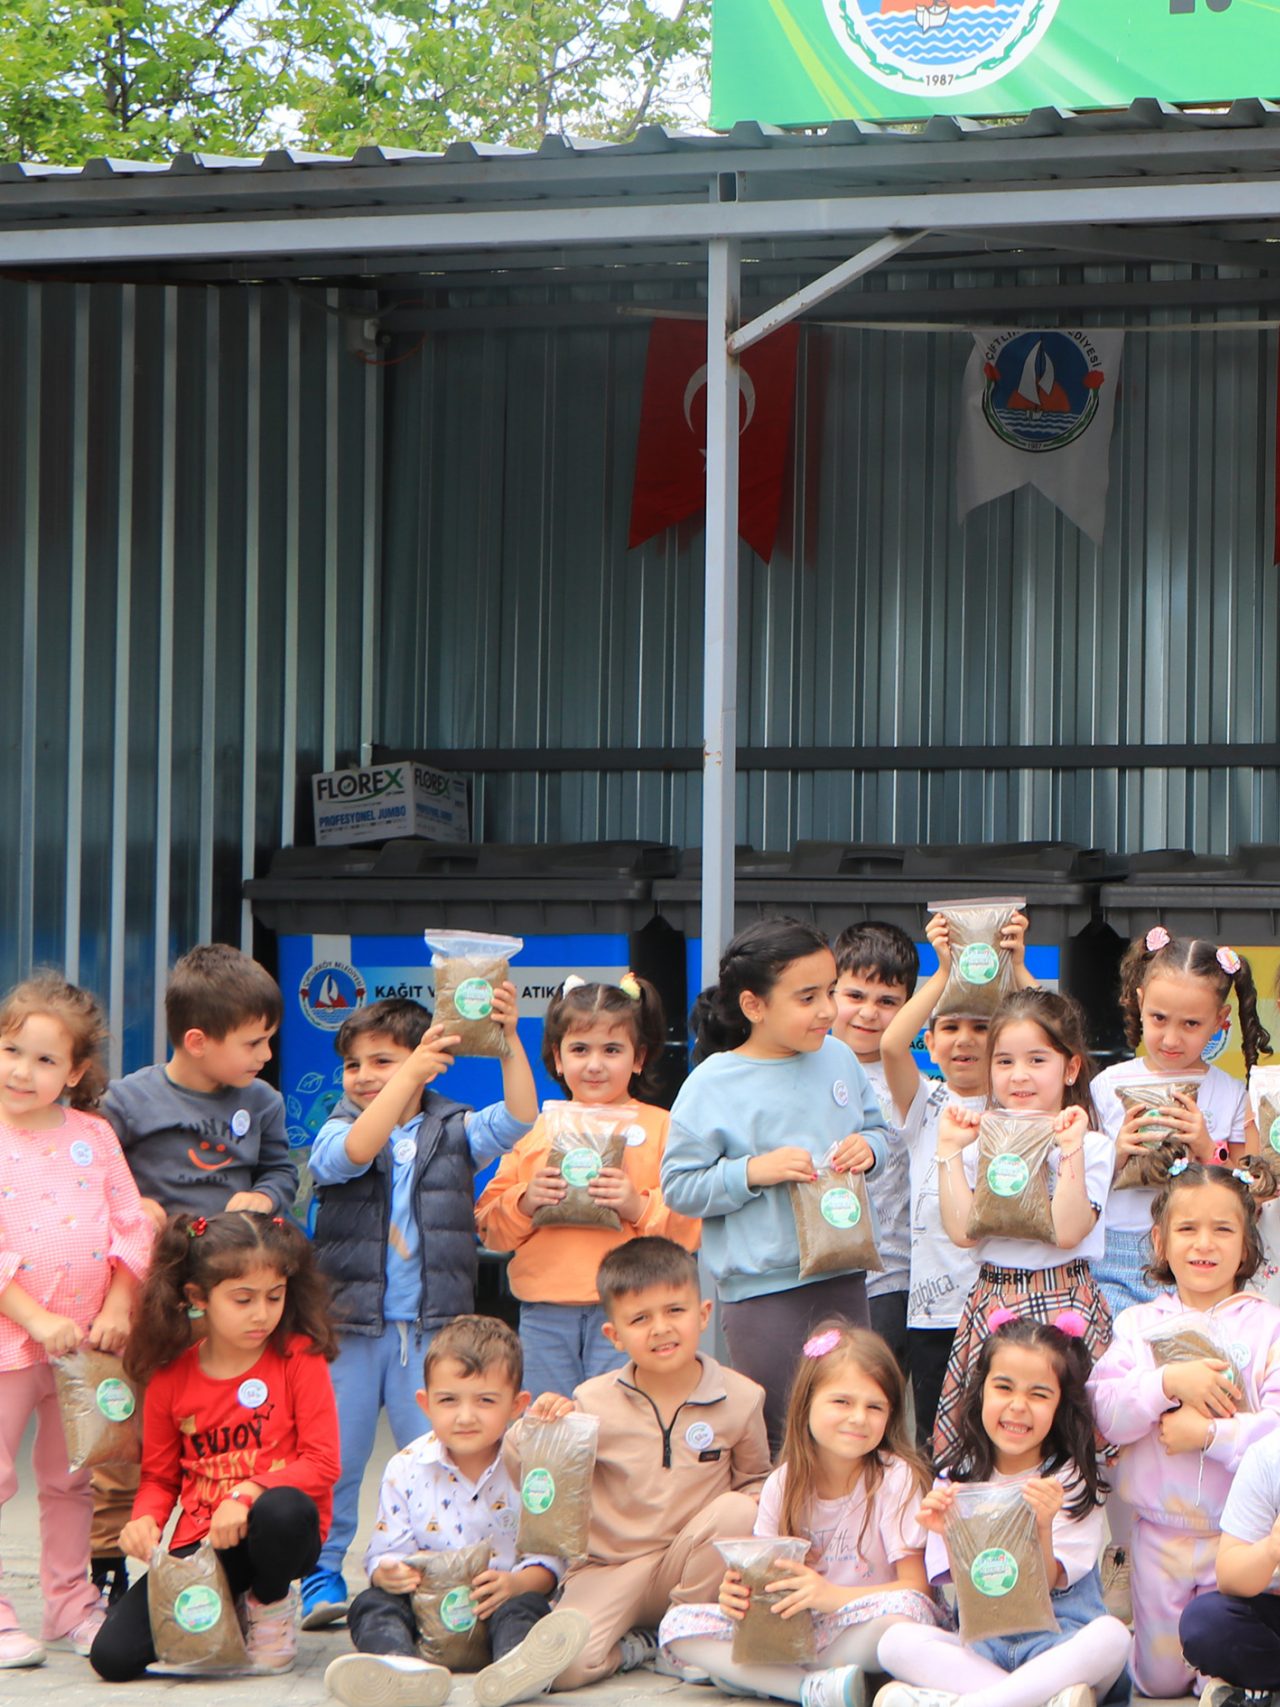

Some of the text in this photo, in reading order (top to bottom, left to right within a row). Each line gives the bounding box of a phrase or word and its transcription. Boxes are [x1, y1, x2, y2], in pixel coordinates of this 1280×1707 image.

[925, 74, 954, 87] 1987
[317, 768, 403, 800] FLOREX
[415, 767, 449, 796] FLOREX
[319, 810, 375, 828] PROFESYONEL
[378, 805, 407, 821] JUMBO
[375, 982, 423, 998] KAĞIT
[521, 986, 556, 998] ATIK
